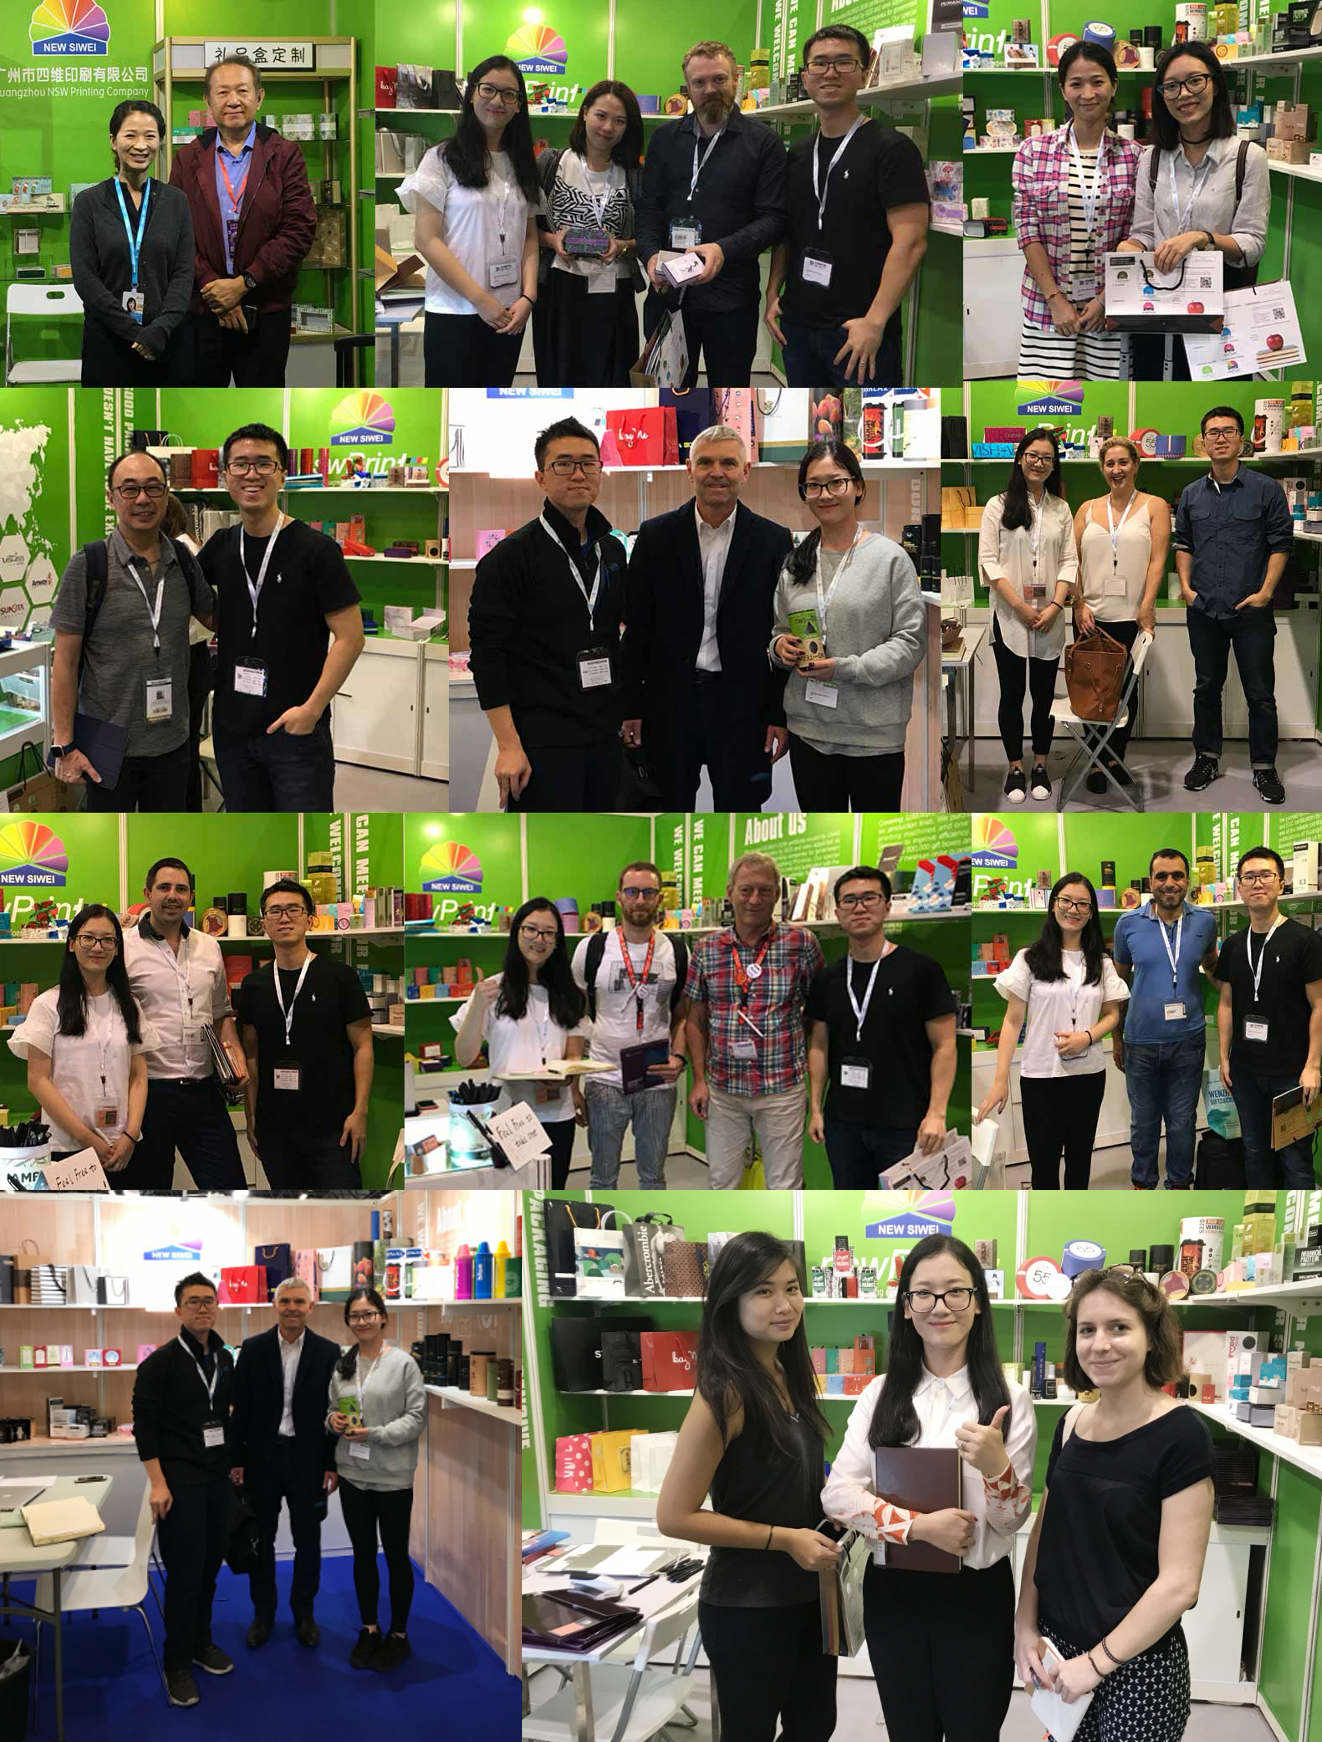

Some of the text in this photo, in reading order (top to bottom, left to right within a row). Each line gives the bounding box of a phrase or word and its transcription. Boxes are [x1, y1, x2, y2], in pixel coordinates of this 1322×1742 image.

[788, 16, 797, 50] CAN
[43, 43, 97, 52] NEW SIWEI
[535, 64, 558, 72] SIWEI
[47, 87, 69, 97] NSW
[70, 87, 105, 98] Printing
[106, 86, 149, 99] Company
[1027, 405, 1073, 413] NEW SIWEI
[339, 434, 384, 443] NEW SIWEI
[356, 814, 369, 853] CAN
[673, 824, 683, 845] WE
[693, 819, 704, 841] WE
[744, 812, 784, 846] About
[1230, 817, 1240, 848] CAN
[693, 844, 704, 873] CAN
[984, 858, 1009, 867] SIWEI
[1, 874, 55, 884] NEW SIWEI
[451, 883, 474, 891] SIWEI
[878, 1224, 905, 1235] NEW
[529, 1190, 554, 1307] PACKAGING
[640, 1225, 656, 1294] Abercrombie
